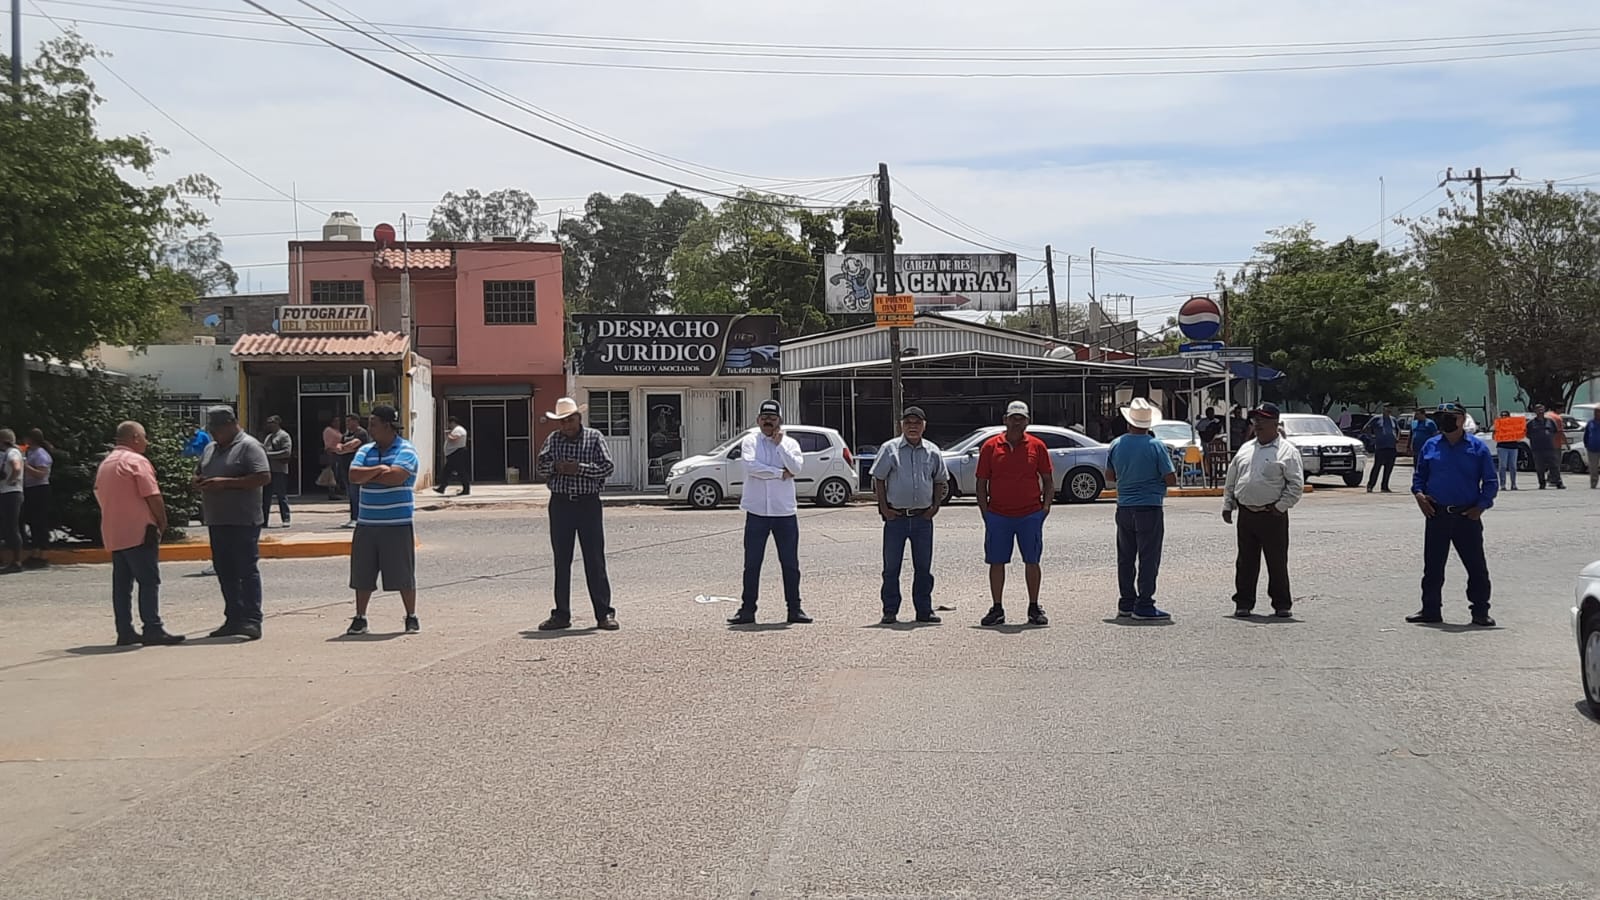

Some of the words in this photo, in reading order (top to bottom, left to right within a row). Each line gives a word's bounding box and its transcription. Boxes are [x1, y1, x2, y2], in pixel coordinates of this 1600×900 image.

[904, 259, 937, 271] CABEZA
[939, 259, 951, 271] DE
[953, 259, 971, 271] RES
[909, 272, 1010, 292] CENTRAL
[282, 320, 301, 331] DEL
[305, 320, 368, 331] ESTUDIANTE
[597, 320, 719, 338] DESPACHO
[600, 340, 716, 362] JURÍDICO
